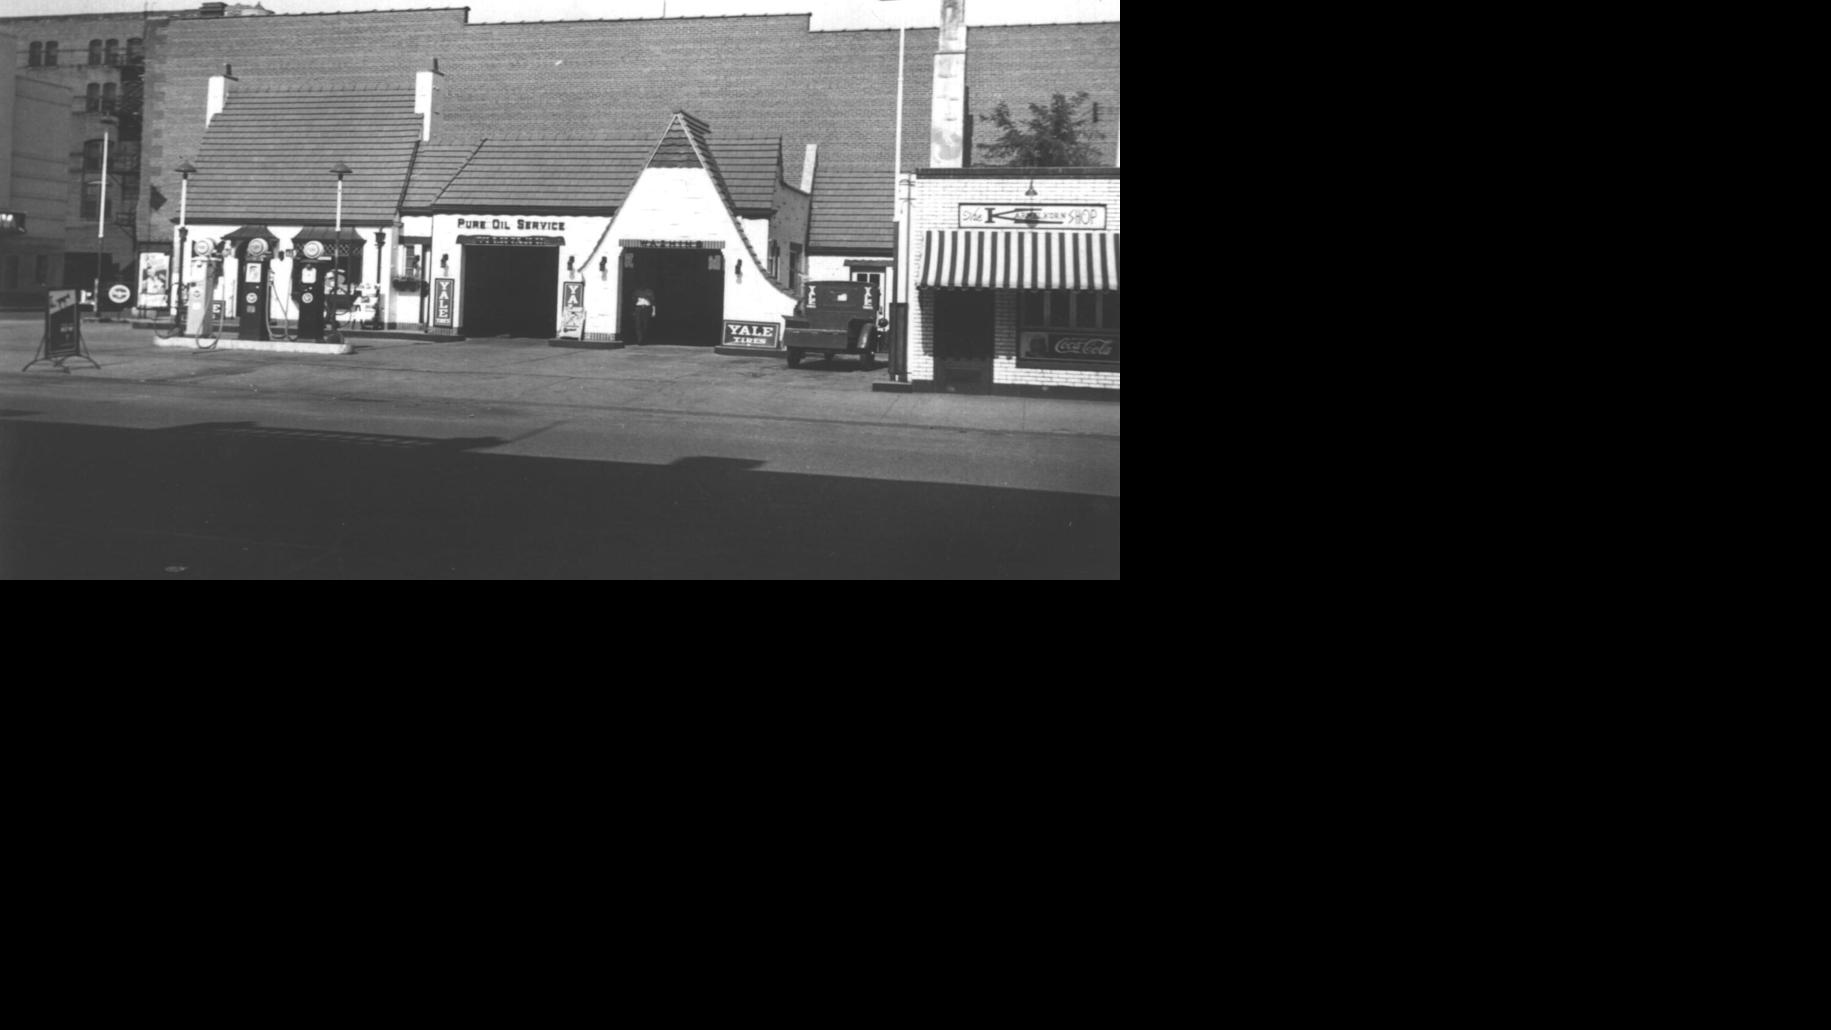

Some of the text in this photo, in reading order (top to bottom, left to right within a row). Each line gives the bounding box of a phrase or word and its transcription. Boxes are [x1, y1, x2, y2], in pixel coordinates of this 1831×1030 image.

[457, 218, 566, 231] PURE OIL SERVICE
[1067, 208, 1098, 225] SHOP
[439, 281, 450, 318] YALE
[567, 285, 579, 307] YA
[728, 324, 774, 337] YALE
